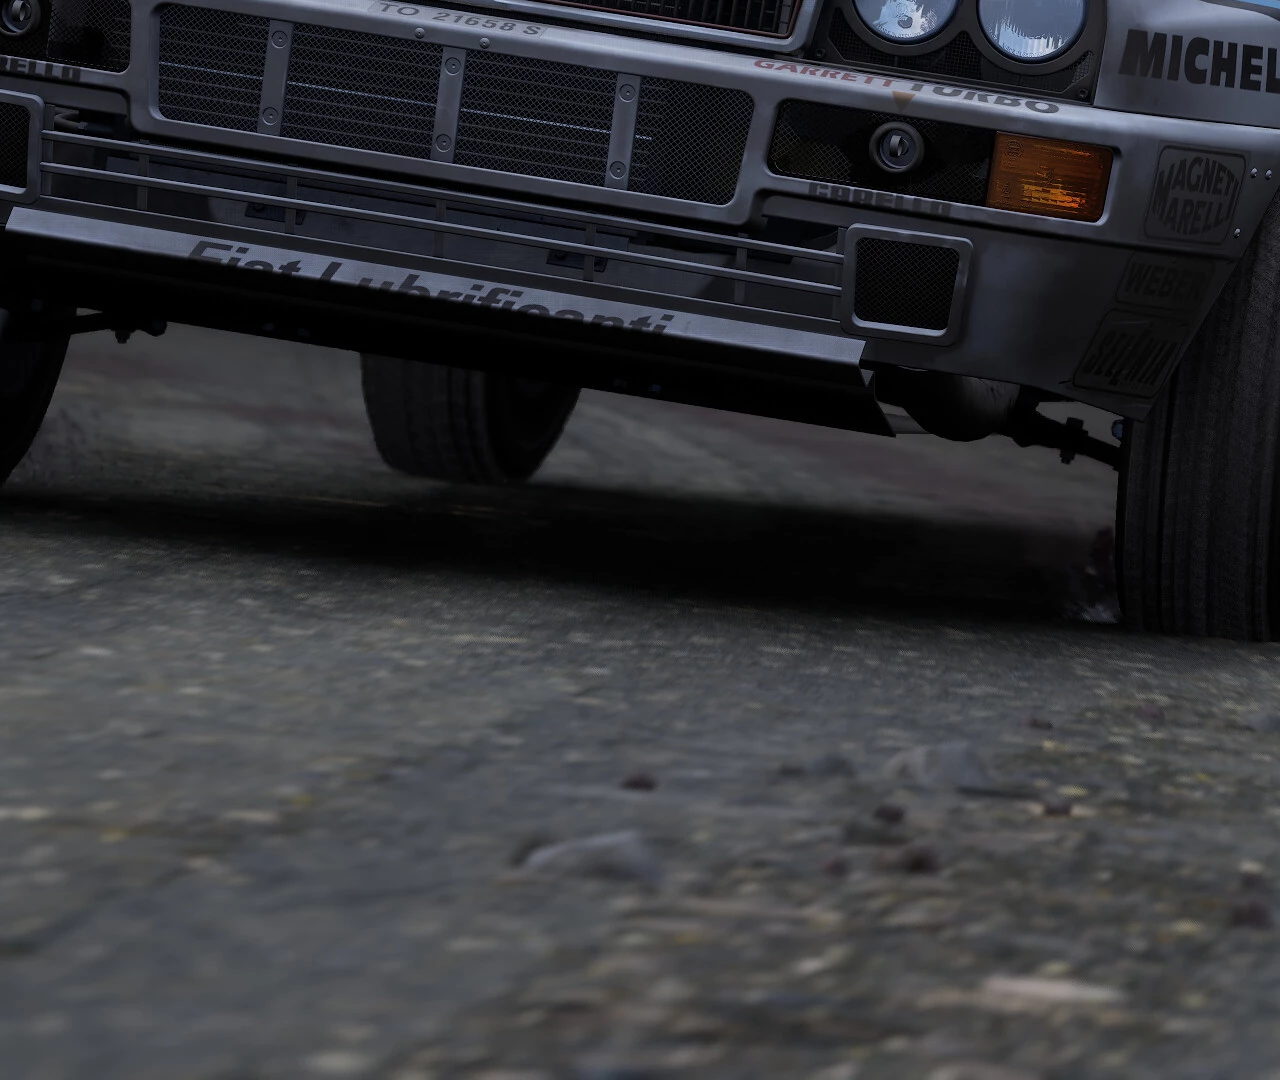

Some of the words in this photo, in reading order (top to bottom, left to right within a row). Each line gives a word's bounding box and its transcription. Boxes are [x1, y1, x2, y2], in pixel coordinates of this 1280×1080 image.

[380, 3, 420, 16] TO
[432, 12, 517, 32] 21658
[522, 25, 542, 36] S
[753, 60, 896, 88] GARRETT
[1124, 262, 1207, 302] WEBER
